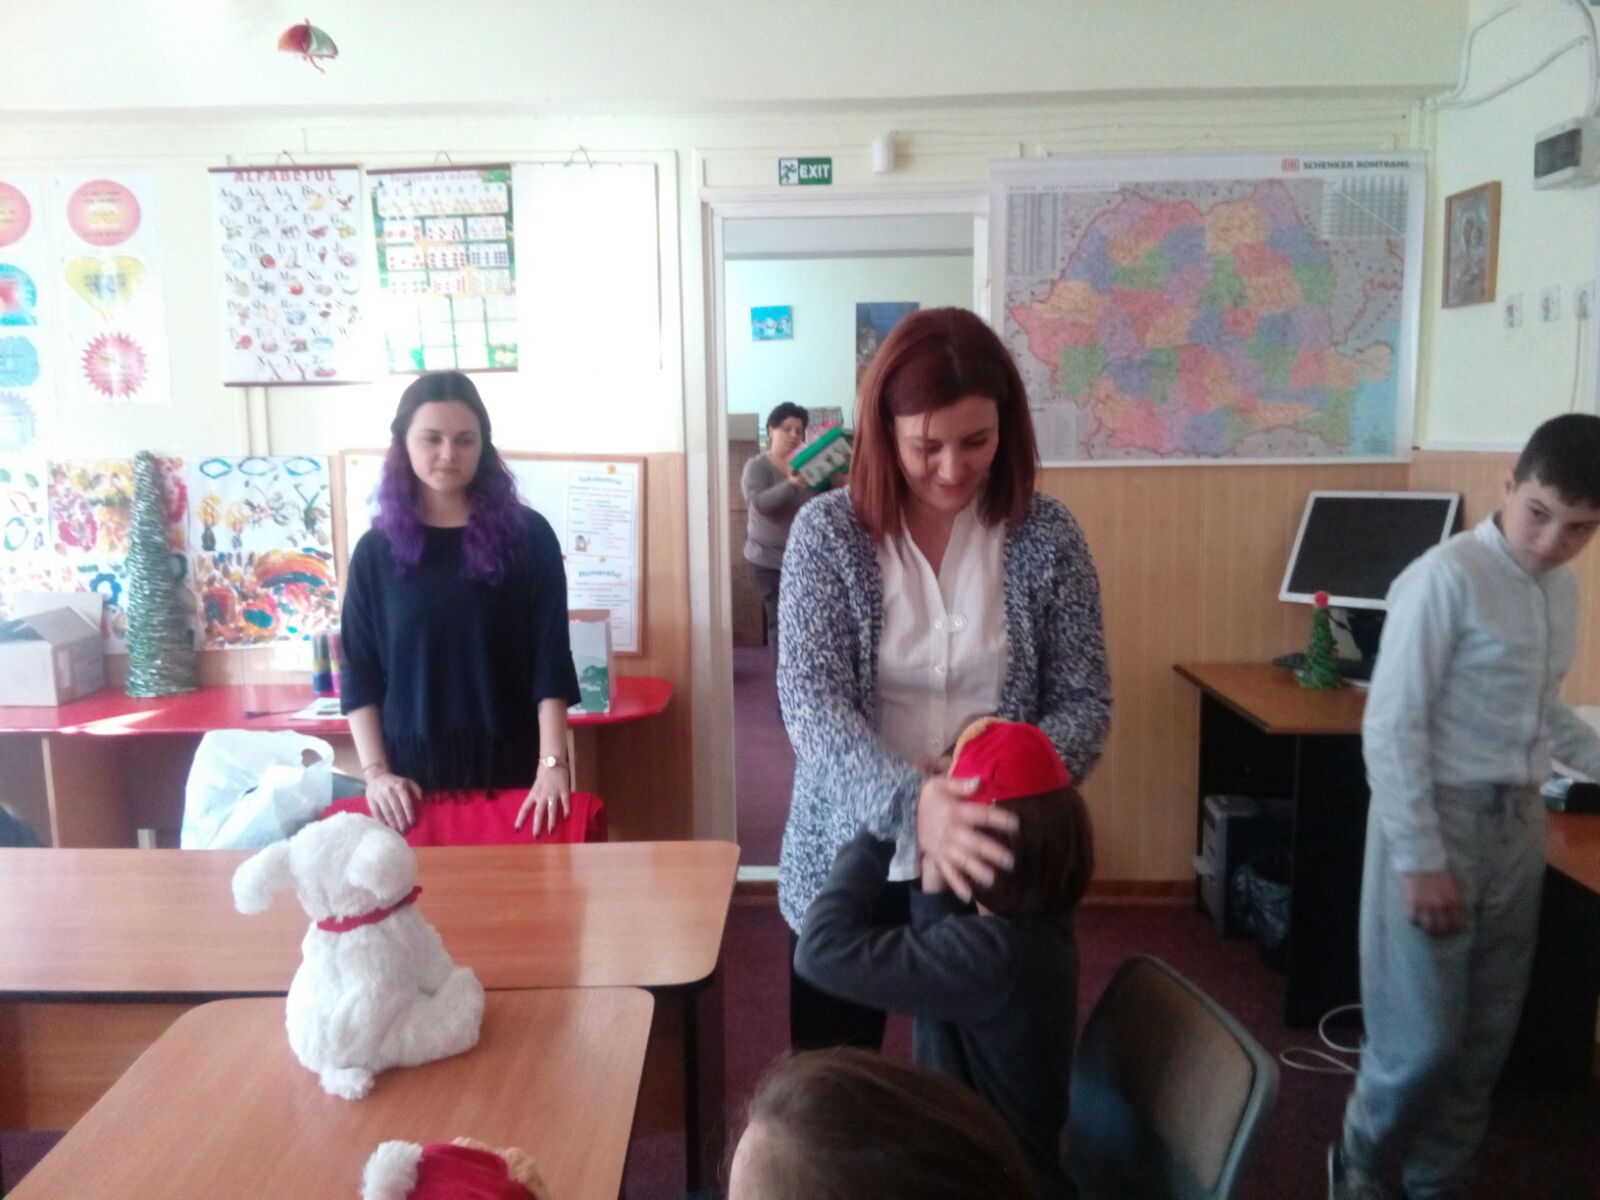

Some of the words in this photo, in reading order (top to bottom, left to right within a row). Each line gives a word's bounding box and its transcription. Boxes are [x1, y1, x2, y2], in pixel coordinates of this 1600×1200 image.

[799, 164, 830, 179] EXIT
[1303, 160, 1353, 170] SCHENKER
[1357, 160, 1409, 169] ROMTRANS
[234, 169, 336, 182] ALFABETUL
